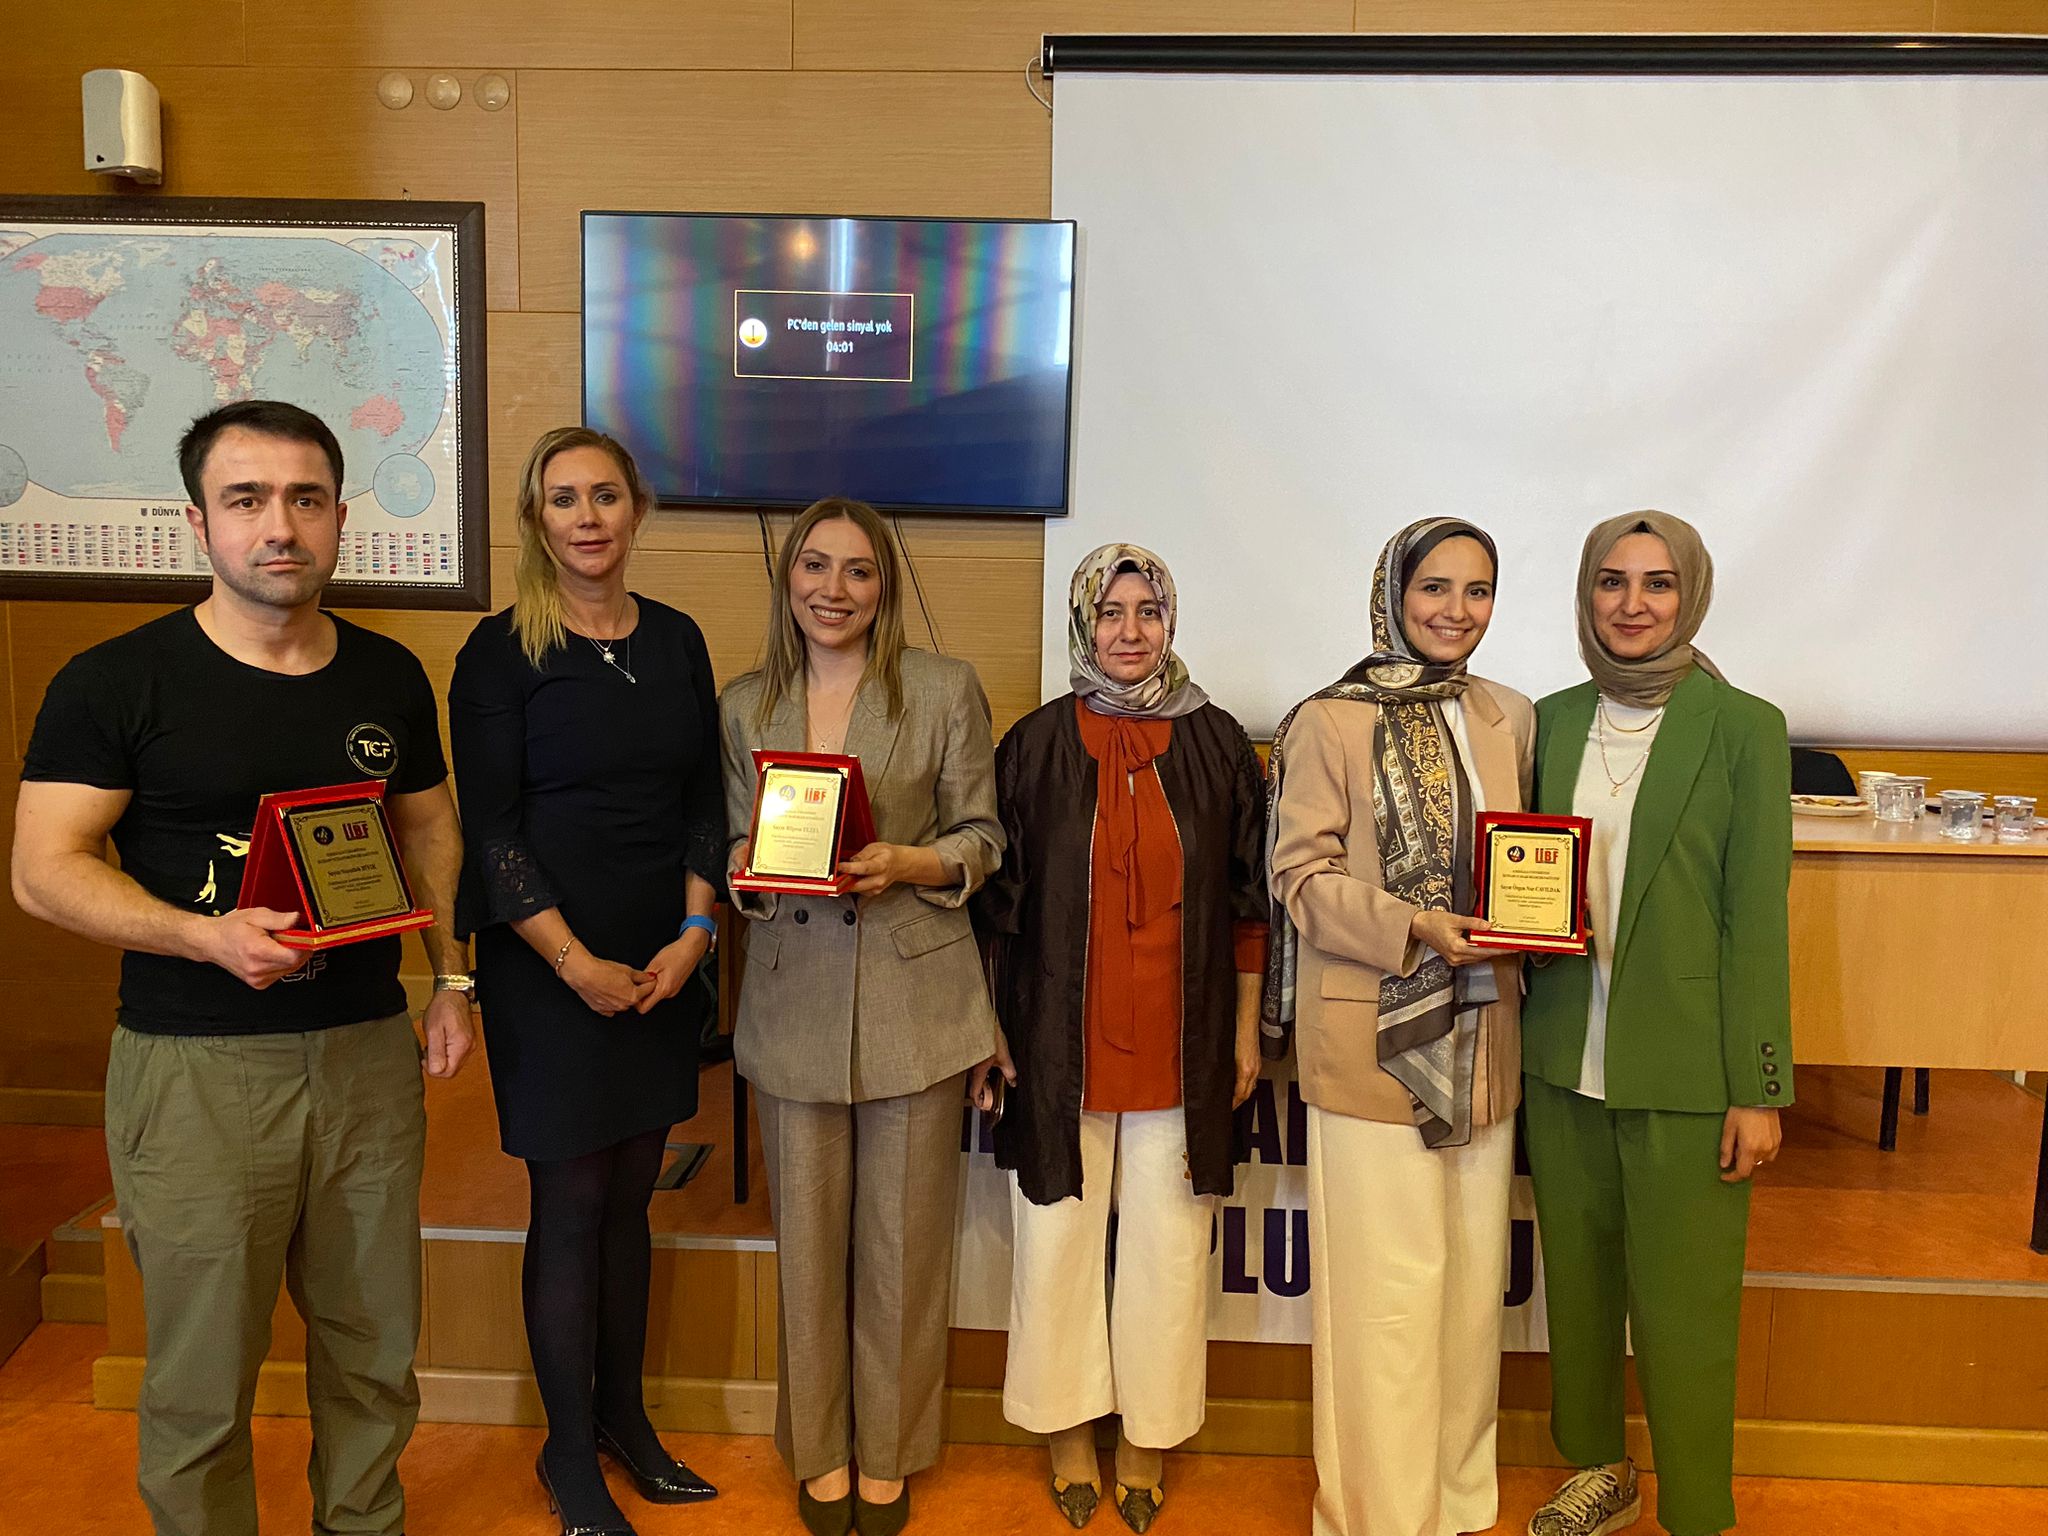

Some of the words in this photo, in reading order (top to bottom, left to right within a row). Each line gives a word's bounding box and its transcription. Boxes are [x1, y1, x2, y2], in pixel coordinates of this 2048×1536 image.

[787, 318, 818, 331] PC'den
[820, 319, 845, 334] gelen
[847, 319, 874, 335] sinyal
[875, 320, 893, 335] yok
[826, 341, 854, 353] 04:01
[152, 506, 181, 516] DÜNYA
